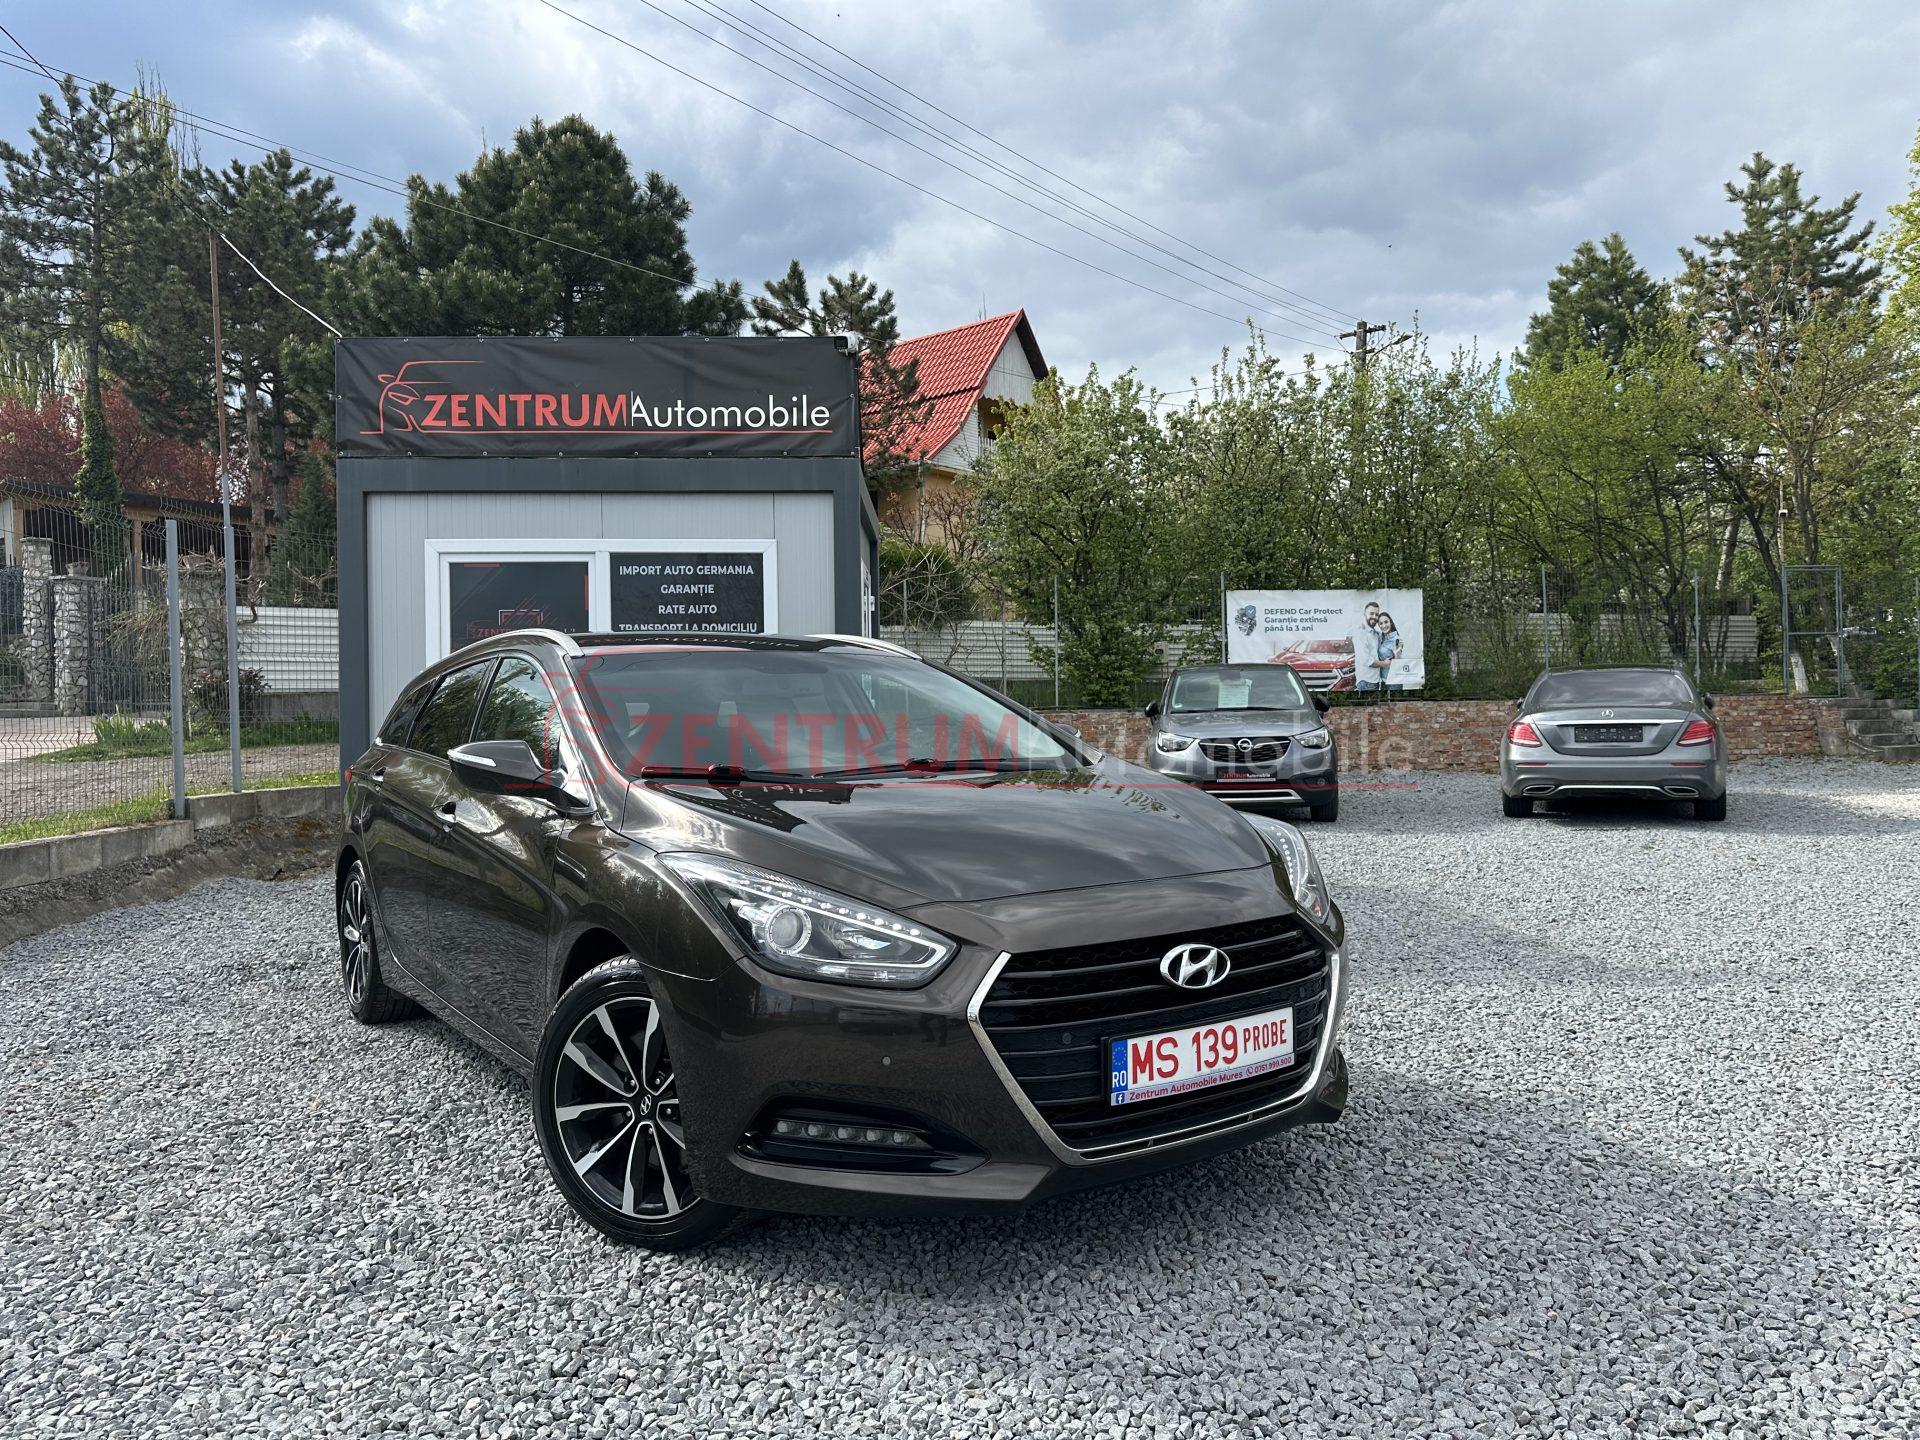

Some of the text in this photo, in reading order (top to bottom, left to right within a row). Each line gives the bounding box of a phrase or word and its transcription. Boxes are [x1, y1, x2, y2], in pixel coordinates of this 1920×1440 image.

[421, 393, 830, 428] ZENTRUM Automobile
[619, 565, 754, 575] IMPORT AUTO GERMANIA
[658, 604, 718, 614] RATE AUTO
[1131, 1018, 1287, 1085] MS 139 PROBE
[1112, 1070, 1127, 1088] RO
[1129, 1087, 1169, 1101] Zentrum
[1170, 1076, 1218, 1093] Automobile
